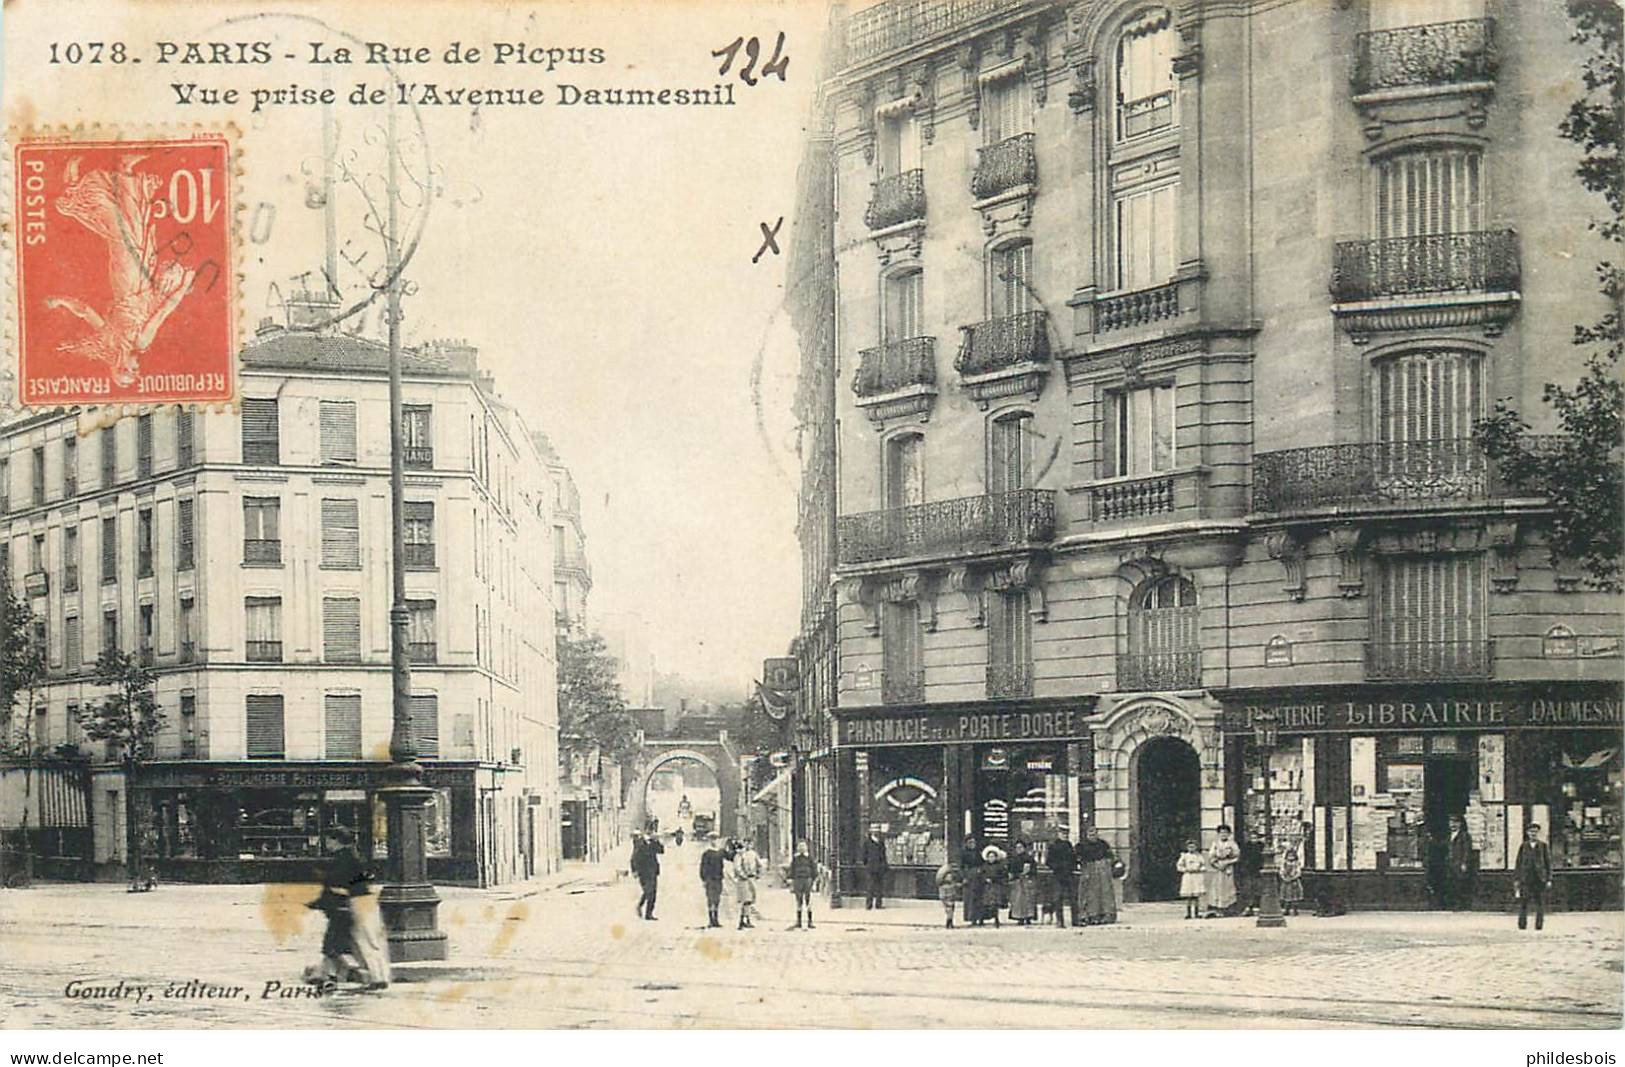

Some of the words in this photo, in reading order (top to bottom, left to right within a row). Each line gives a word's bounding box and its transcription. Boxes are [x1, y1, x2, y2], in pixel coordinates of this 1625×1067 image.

[712, 31, 789, 86] 124
[25, 160, 46, 247] POSTES
[28, 376, 111, 395] FRANÇAISE
[847, 717, 929, 742] PHARMACIE
[959, 712, 1011, 739] PORTE
[1346, 701, 1505, 726] LIBRAIRIE
